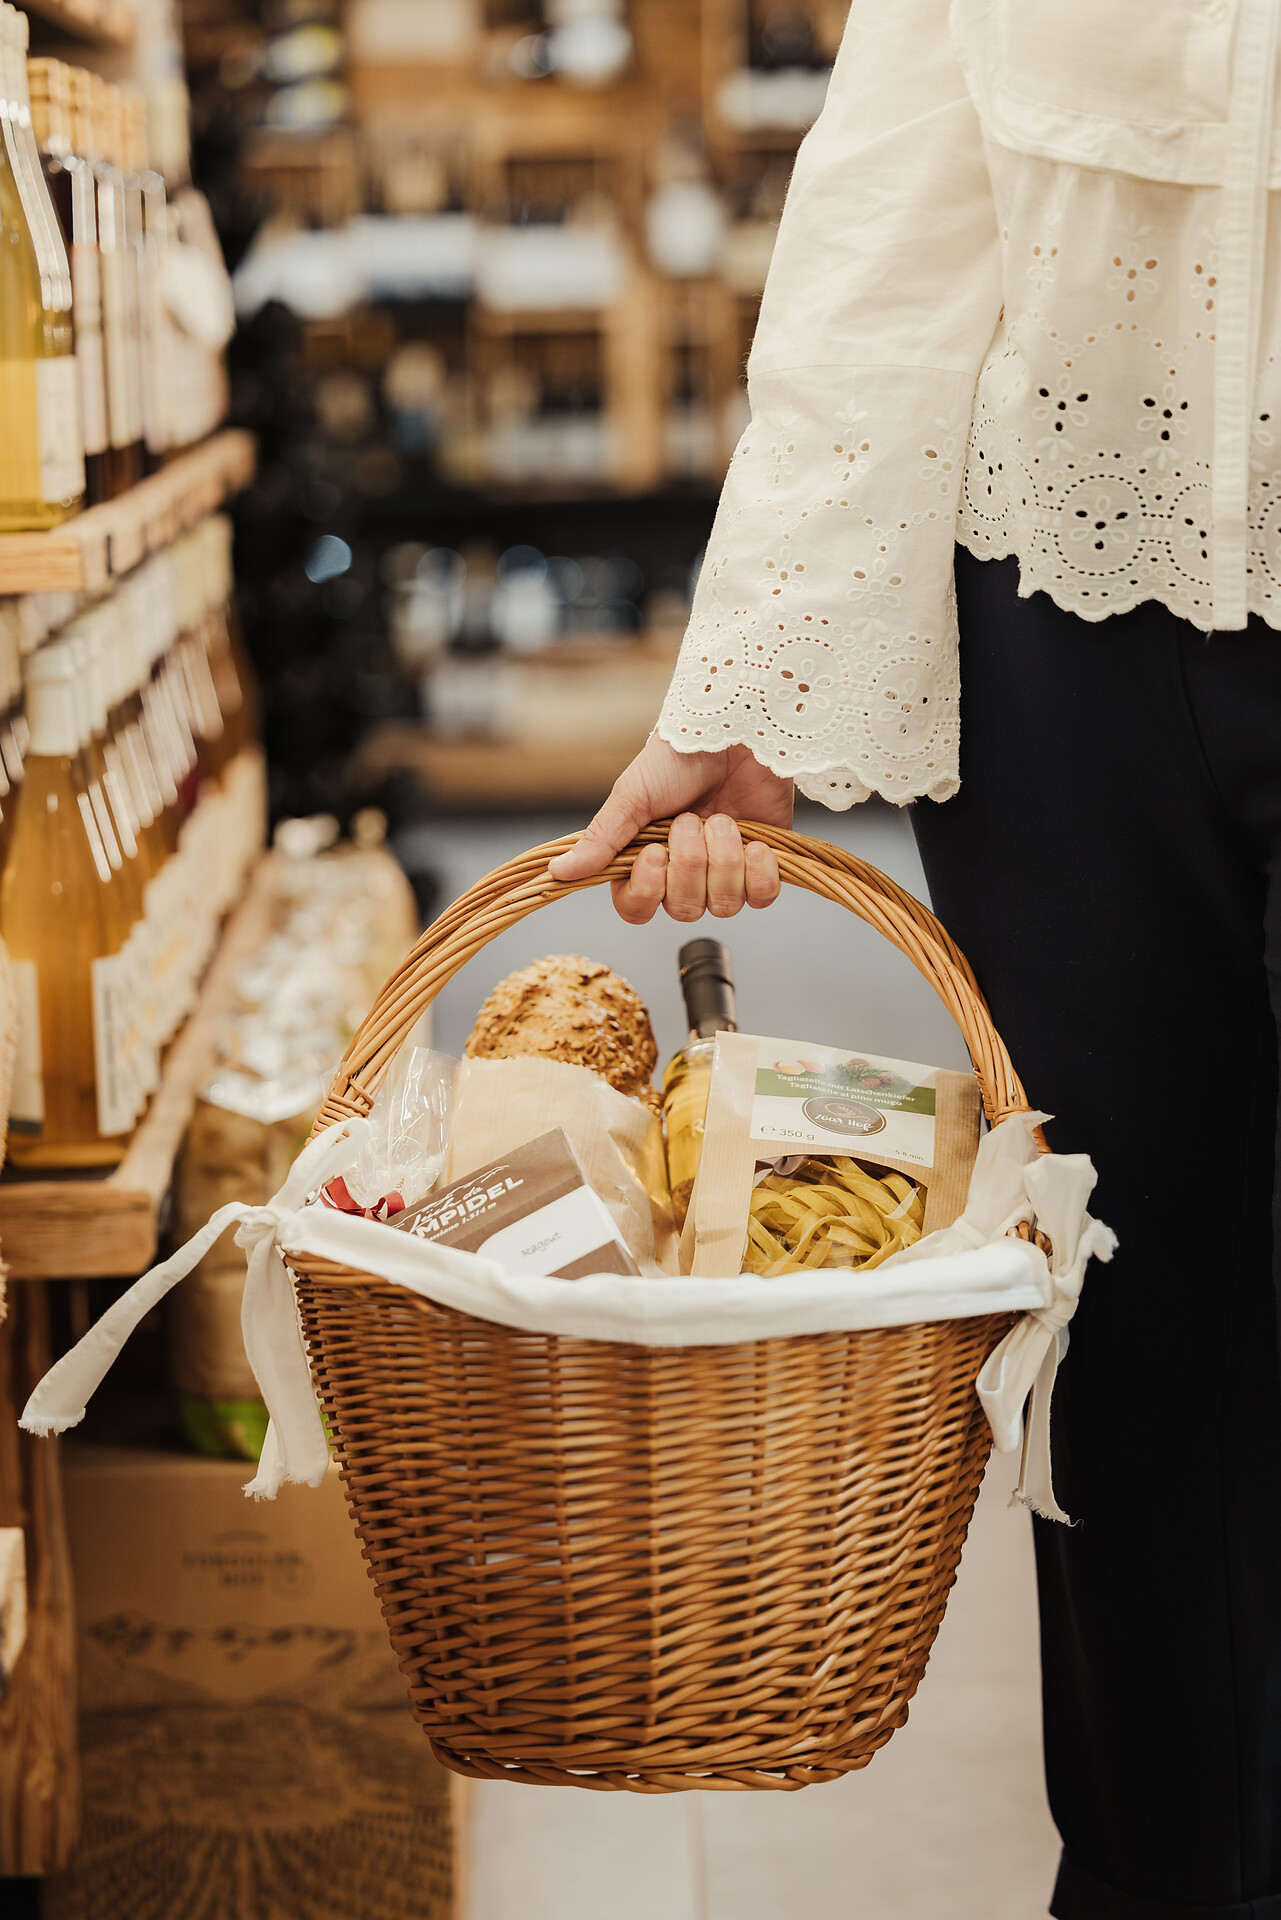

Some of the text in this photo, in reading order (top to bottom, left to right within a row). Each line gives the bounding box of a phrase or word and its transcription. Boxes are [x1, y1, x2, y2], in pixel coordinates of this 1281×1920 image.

[777, 1074, 826, 1086] Tagliatelle
[846, 1086, 916, 1102] Latschenkiefer
[790, 1082, 838, 1095] Tagliatelle
[850, 1093, 873, 1102] pino
[874, 1098, 902, 1107] mugo
[779, 1128, 803, 1138] 350
[416, 1177, 524, 1239] MPIDEL
[519, 1231, 561, 1255] Ragout
